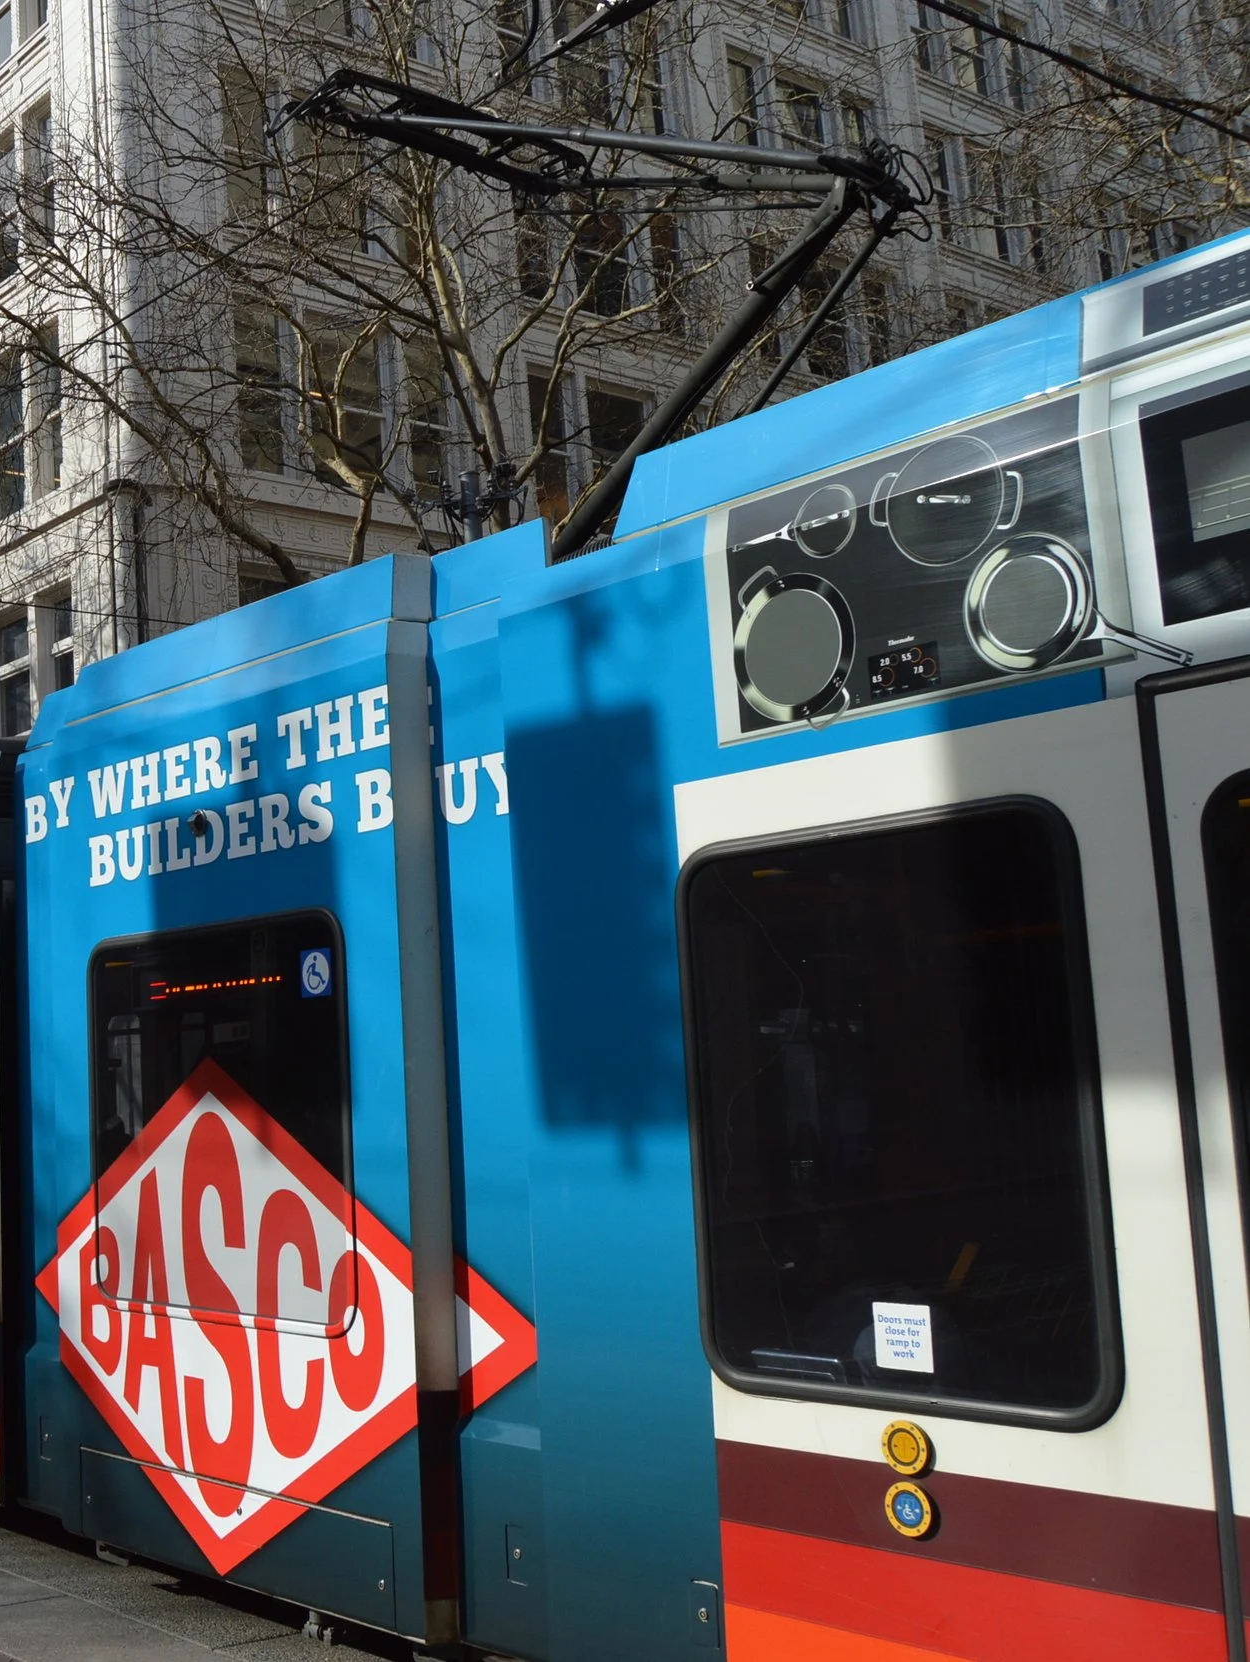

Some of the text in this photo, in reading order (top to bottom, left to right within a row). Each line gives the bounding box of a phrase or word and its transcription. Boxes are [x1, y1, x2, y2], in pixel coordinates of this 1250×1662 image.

[25, 776, 75, 844] BY
[87, 723, 259, 819] WHERE
[88, 780, 334, 888] BUILDERS
[78, 1112, 385, 1518] BASCO
[877, 1314, 926, 1326] Doors must
[885, 1325, 920, 1337] close for
[886, 1338, 921, 1349] ramp to
[892, 1349, 915, 1358] work
